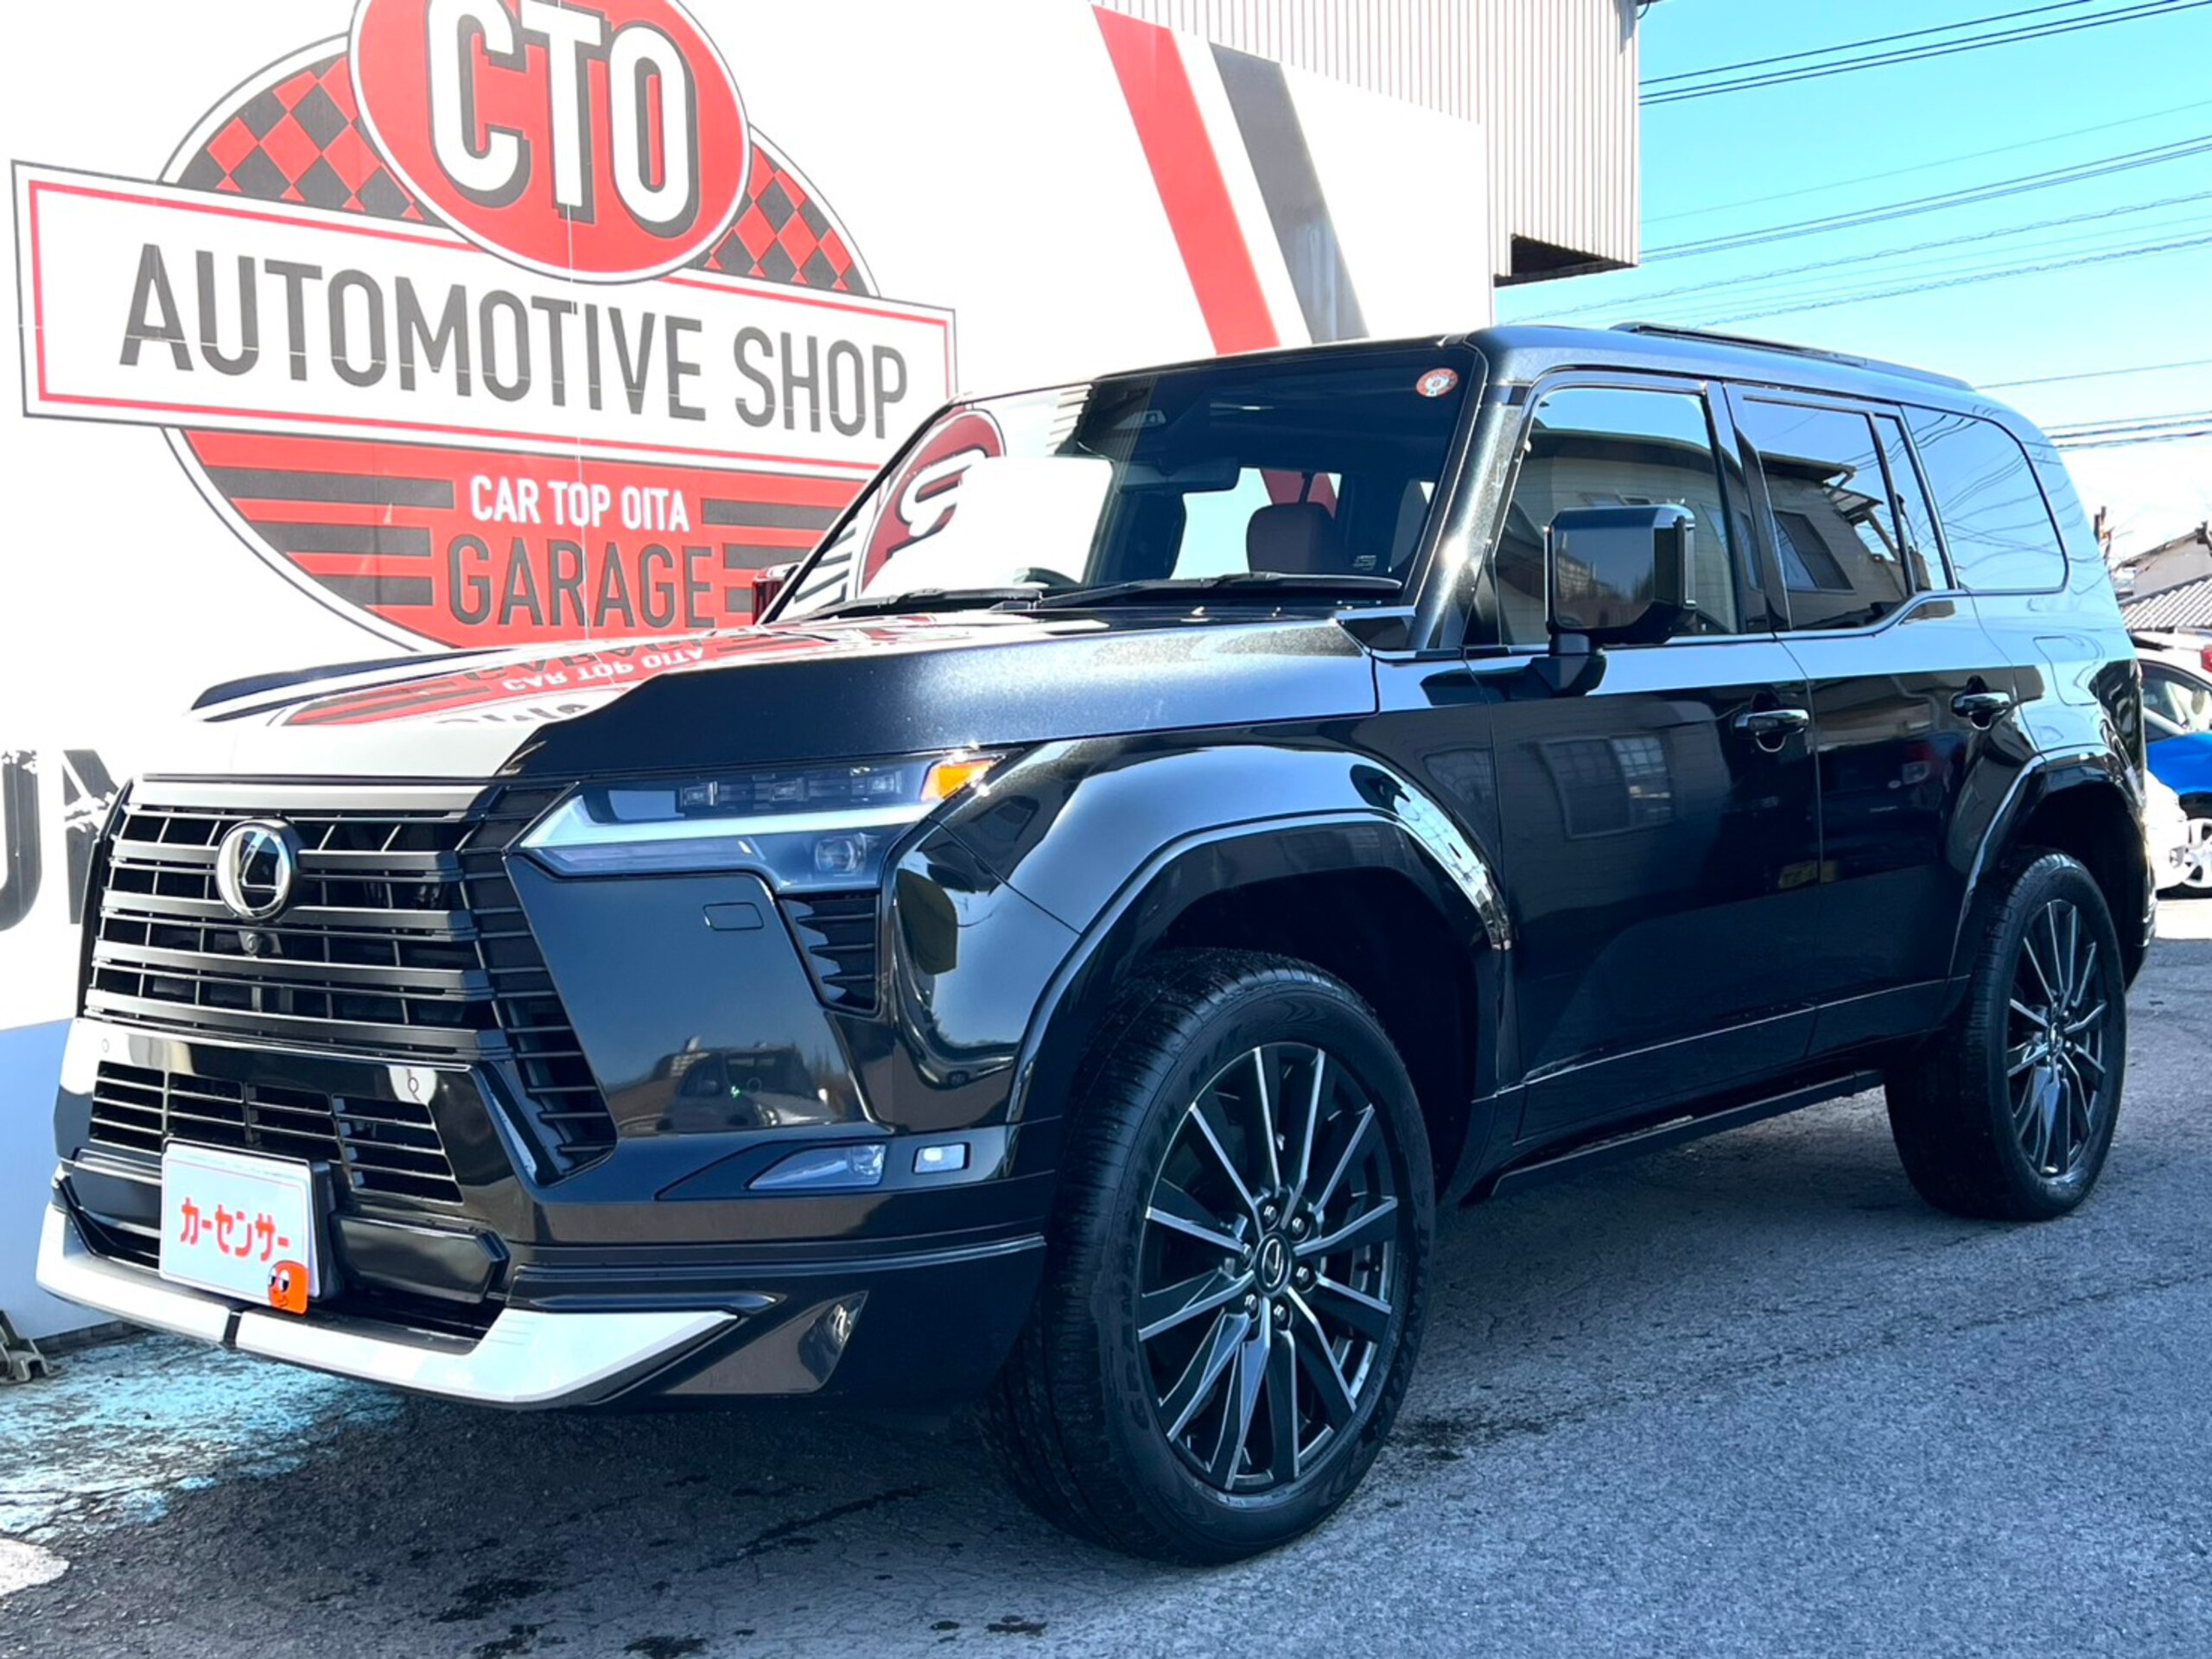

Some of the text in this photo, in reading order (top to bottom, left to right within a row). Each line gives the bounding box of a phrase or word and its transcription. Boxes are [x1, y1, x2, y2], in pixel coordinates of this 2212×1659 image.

[426, 0, 699, 238] CTO
[119, 243, 908, 440] AUTOMOTIVE SHOP
[469, 474, 690, 533] CAR TOP OITA
[448, 534, 715, 629] GARAGE
[180, 1197, 289, 1262] カーセンサー
